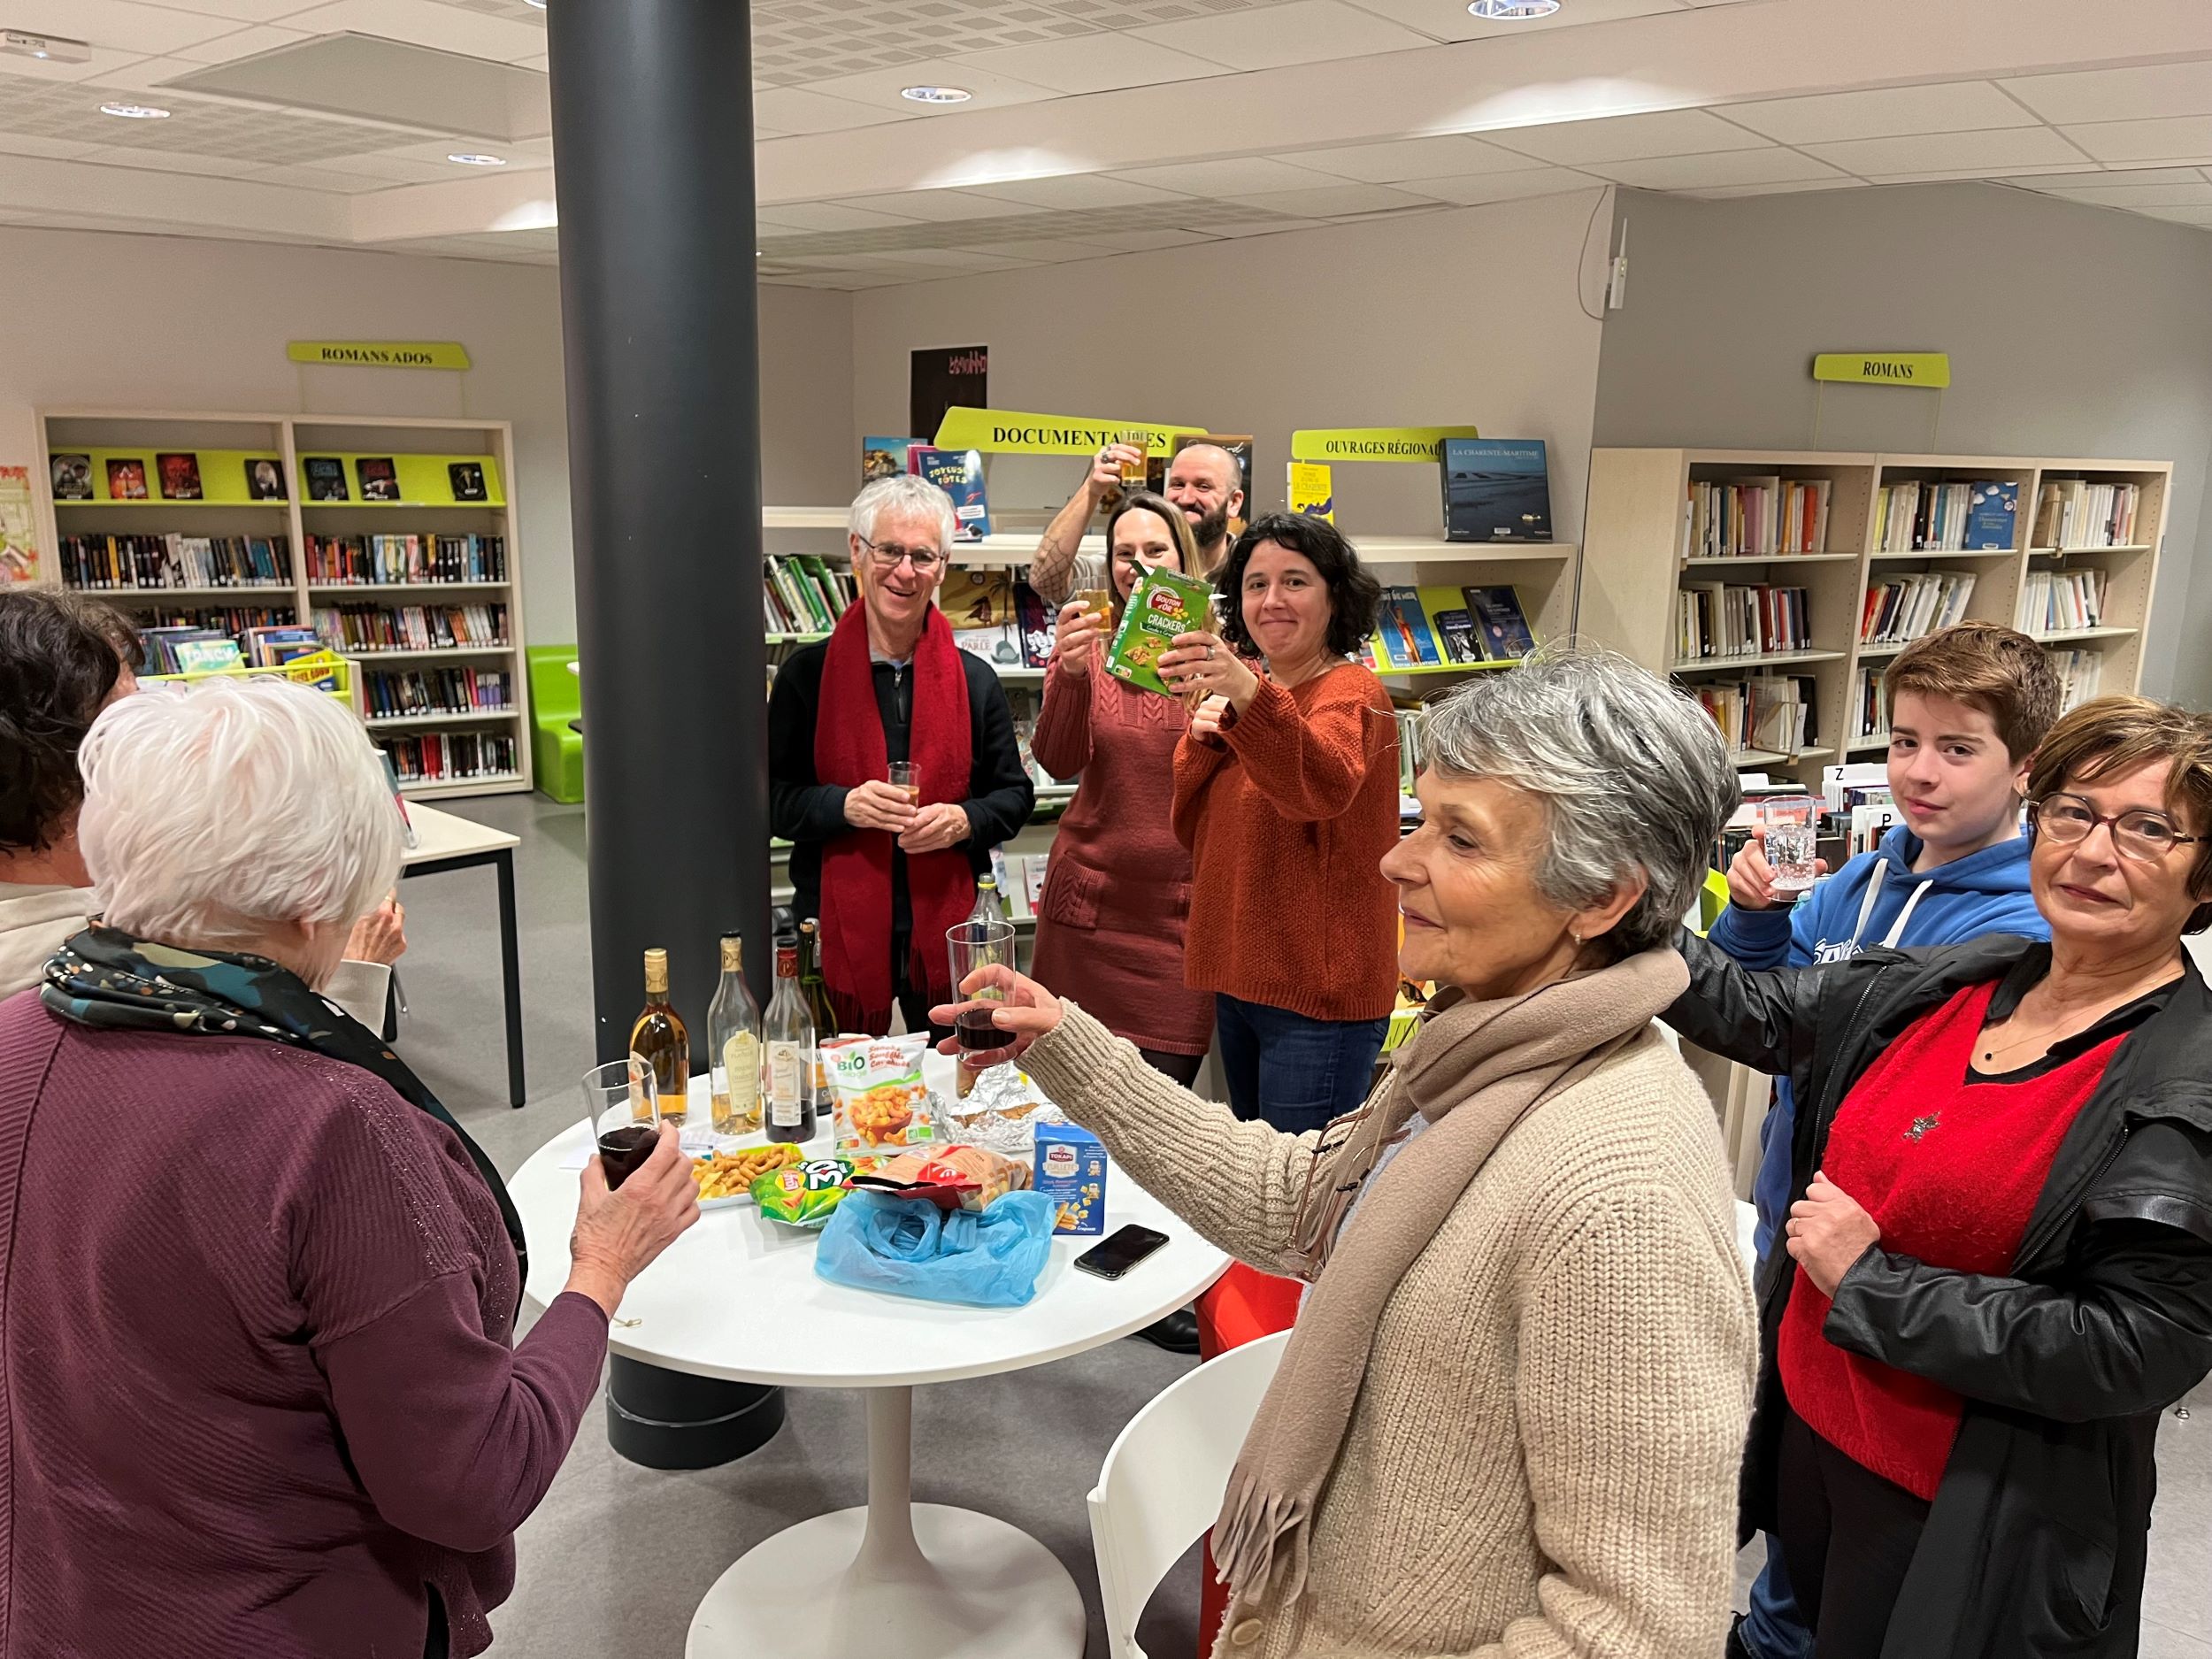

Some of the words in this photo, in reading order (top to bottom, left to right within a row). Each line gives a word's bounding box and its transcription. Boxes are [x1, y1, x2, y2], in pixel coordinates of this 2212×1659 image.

[321, 348, 389, 363] ROMANS
[392, 352, 434, 365] ADOS
[1863, 361, 1914, 379] ROMANS
[1326, 440, 1385, 454] OUVRAGES
[1387, 439, 1441, 457] RÉGIONAU
[1155, 594, 1182, 608] BOUTON
[1148, 613, 1187, 634] CRACKERS
[961, 641, 991, 651] PARLE
[1834, 767, 1845, 780] Z
[1882, 813, 1892, 827] P
